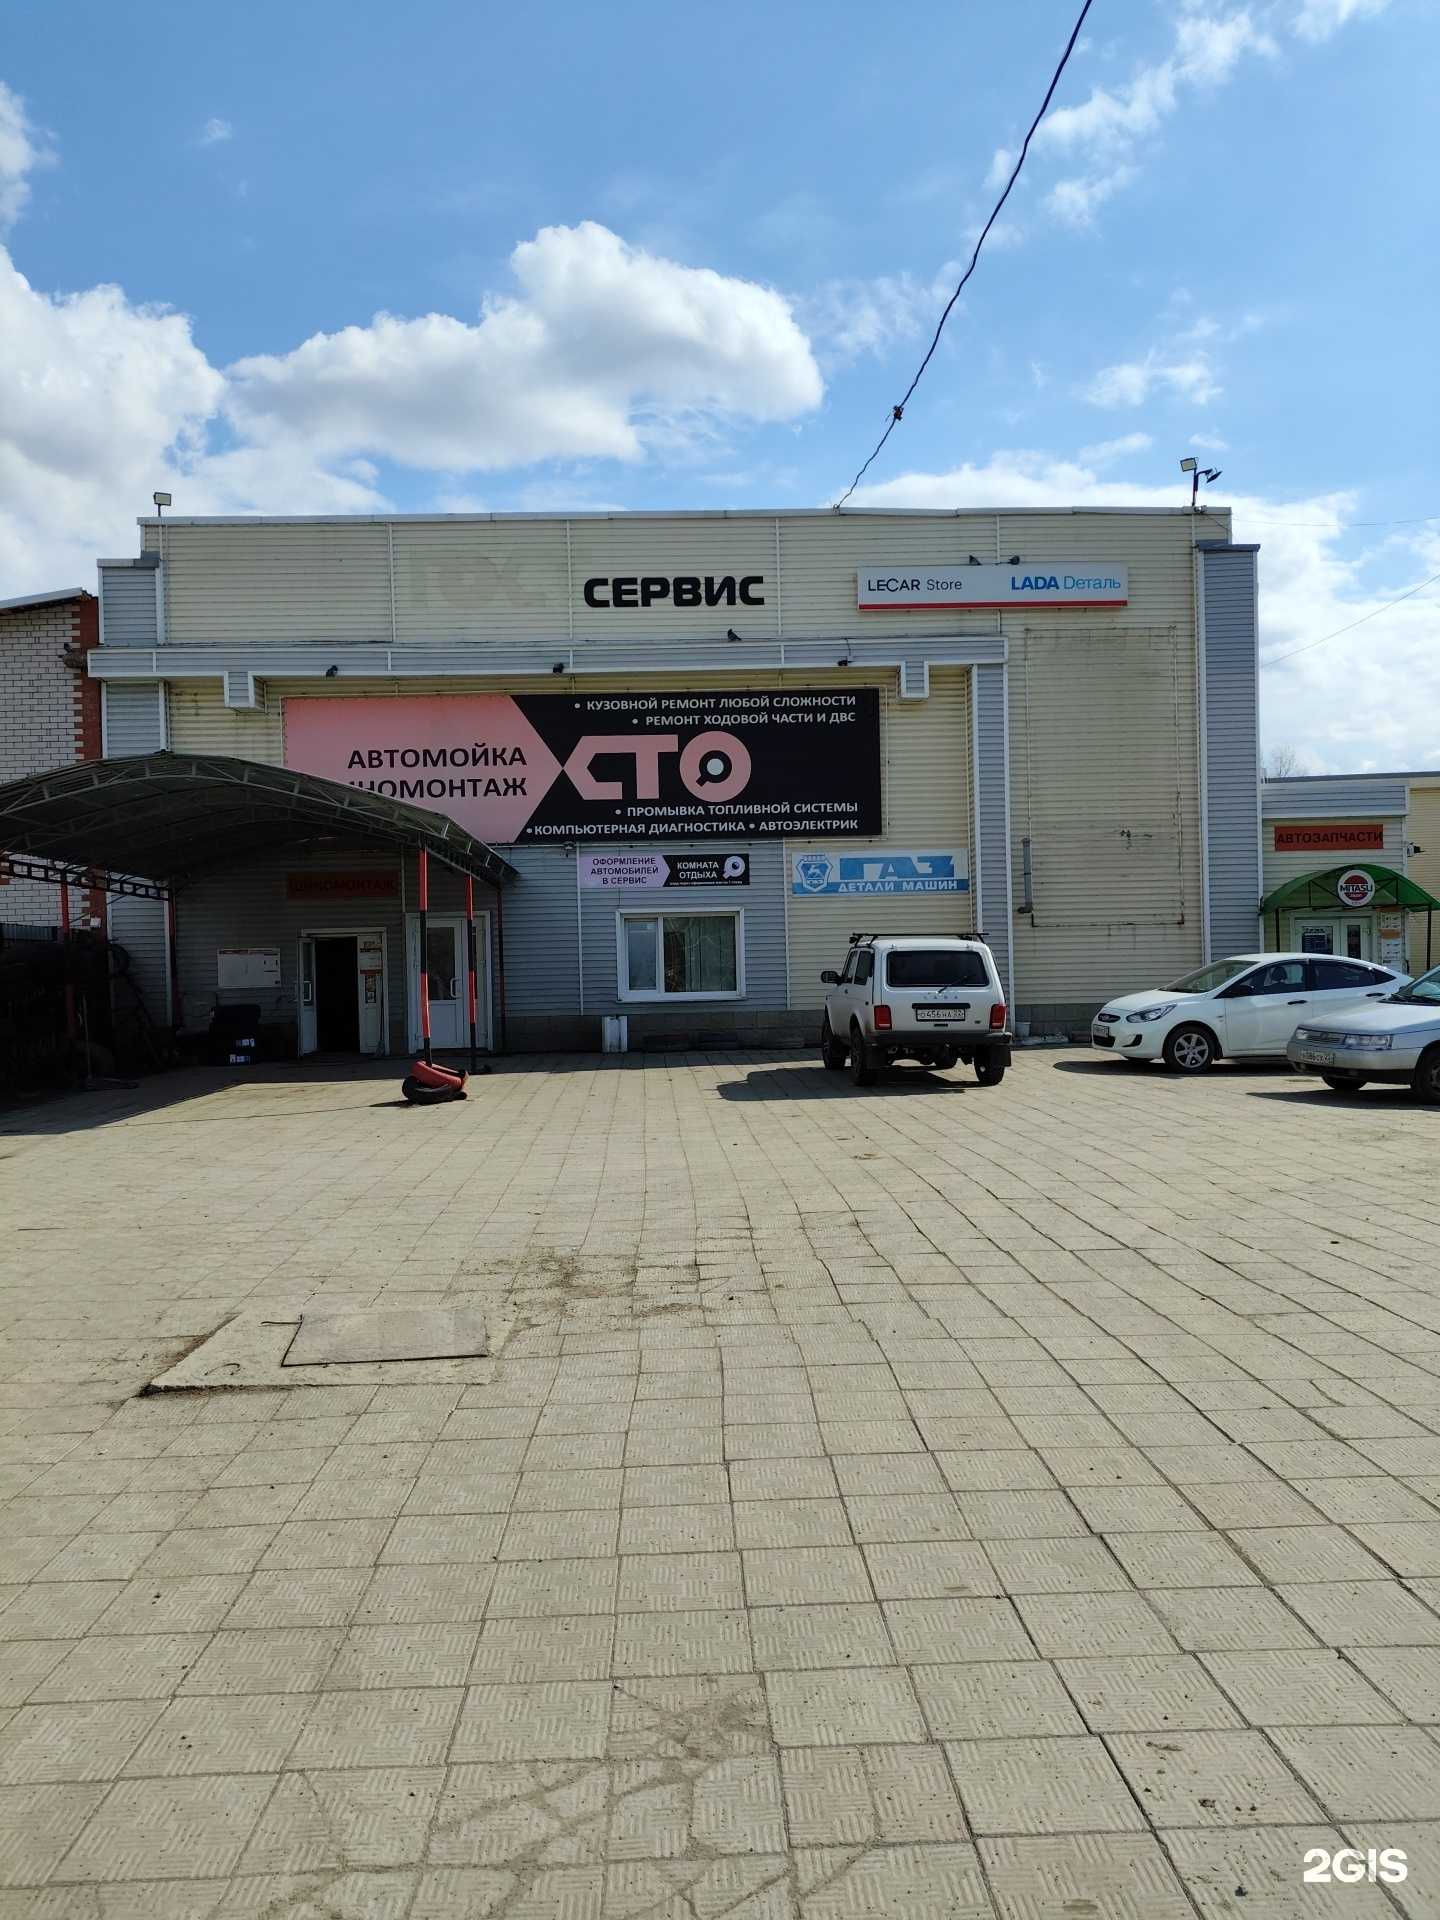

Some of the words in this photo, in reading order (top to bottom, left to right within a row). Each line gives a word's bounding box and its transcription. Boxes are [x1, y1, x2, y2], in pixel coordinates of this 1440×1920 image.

[867, 578, 920, 592] LECAR
[926, 579, 963, 591] Store
[1011, 576, 1059, 590] LADA
[584, 576, 765, 607] СЕРВИС
[587, 697, 657, 710] КУЗОВНОЙ
[662, 699, 716, 710] РЕМОНТ
[719, 696, 769, 708] ЛЮБОЙ
[773, 696, 856, 707] СЛОЖНОСТИ
[646, 715, 700, 726] РЕМОНТ
[703, 713, 768, 726] ХОДОВОЙ
[772, 713, 813, 724] ЧАСТИ
[817, 713, 826, 723] И
[829, 712, 856, 723] ДВС
[347, 742, 528, 769] АВТОМОЙКА
[349, 777, 528, 799] НОМОНТАЖ
[627, 805, 705, 817] ПРОМЫВКА
[708, 802, 790, 816] ТОПЛИВНОЙ
[794, 802, 858, 814] СИСТЕМЫ
[534, 822, 646, 836] КОМПЬЮТЕРНАЯ
[649, 821, 746, 836] ДИАГНОСТИКА
[759, 819, 859, 832] АВТОЭЛЕКТРИК
[1277, 832, 1383, 844] АВТОЗАПЧАСТИ
[592, 857, 656, 866] ОФОРМЛЕНИЕ
[677, 861, 719, 870] КОМНАТА
[840, 856, 954, 879] ГАЗ
[591, 866, 659, 876] АВТОМОБИЛЕЙ
[679, 871, 718, 880] ОТДЫХА
[602, 877, 608, 885] В
[610, 876, 647, 885] СЕРВИС
[838, 882, 894, 893] ДЕТАЛИ
[902, 880, 957, 891] МАШИН
[1340, 884, 1373, 892] MITASU
